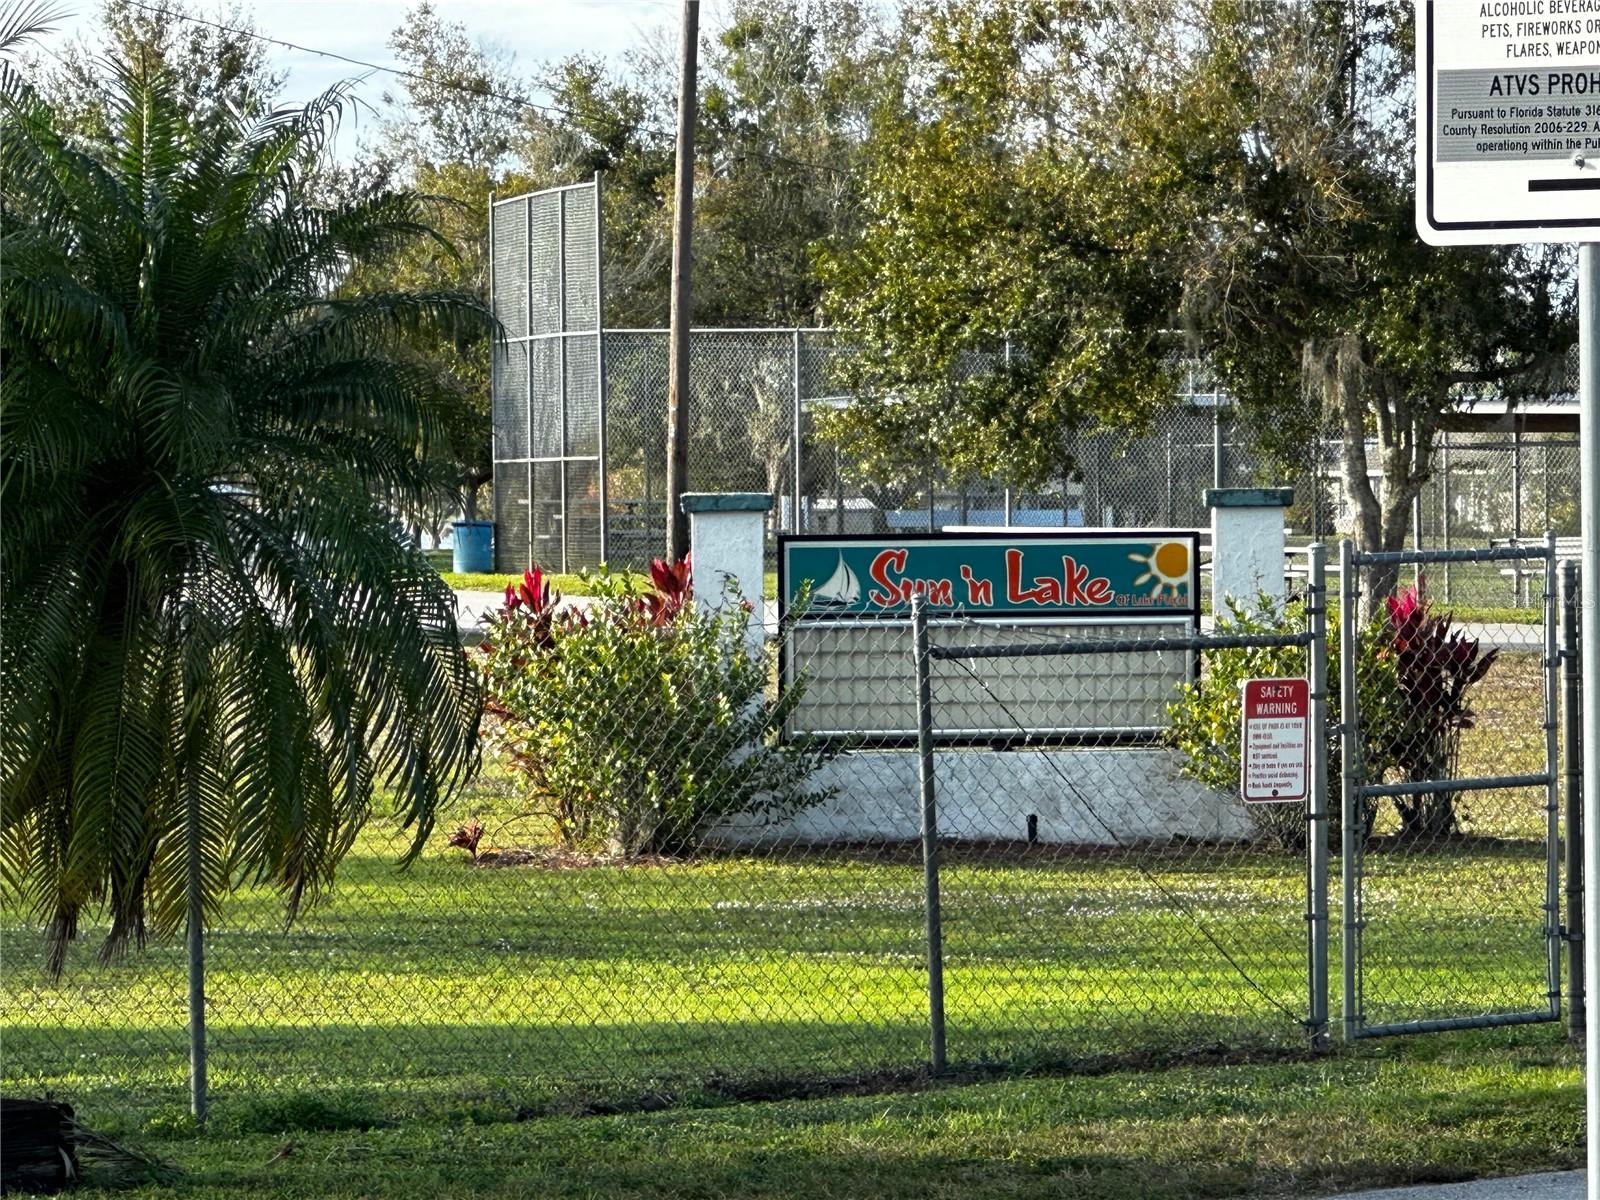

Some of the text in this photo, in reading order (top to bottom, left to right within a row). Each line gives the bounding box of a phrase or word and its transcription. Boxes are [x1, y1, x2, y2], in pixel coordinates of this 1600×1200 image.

[1479, 1, 1545, 17] ALCOHOLIC
[1481, 19, 1600, 38] PETS, FIREWORKS OR
[1506, 42, 1552, 58] FLARES,
[1489, 72, 1600, 97] ATVS PROH
[1451, 107, 1494, 119] Pursuant
[1497, 107, 1507, 118] to
[1510, 106, 1544, 118] Florida
[1547, 105, 1581, 118] Statute
[1443, 124, 1477, 138] County
[1481, 122, 1531, 135] Resolution
[1532, 138, 1563, 150] within
[1566, 137, 1582, 150] the
[869, 549, 953, 607] Sun
[1005, 549, 1115, 606] Lake
[1260, 685, 1295, 698] SAFETY
[1256, 702, 1297, 715] WARNING
